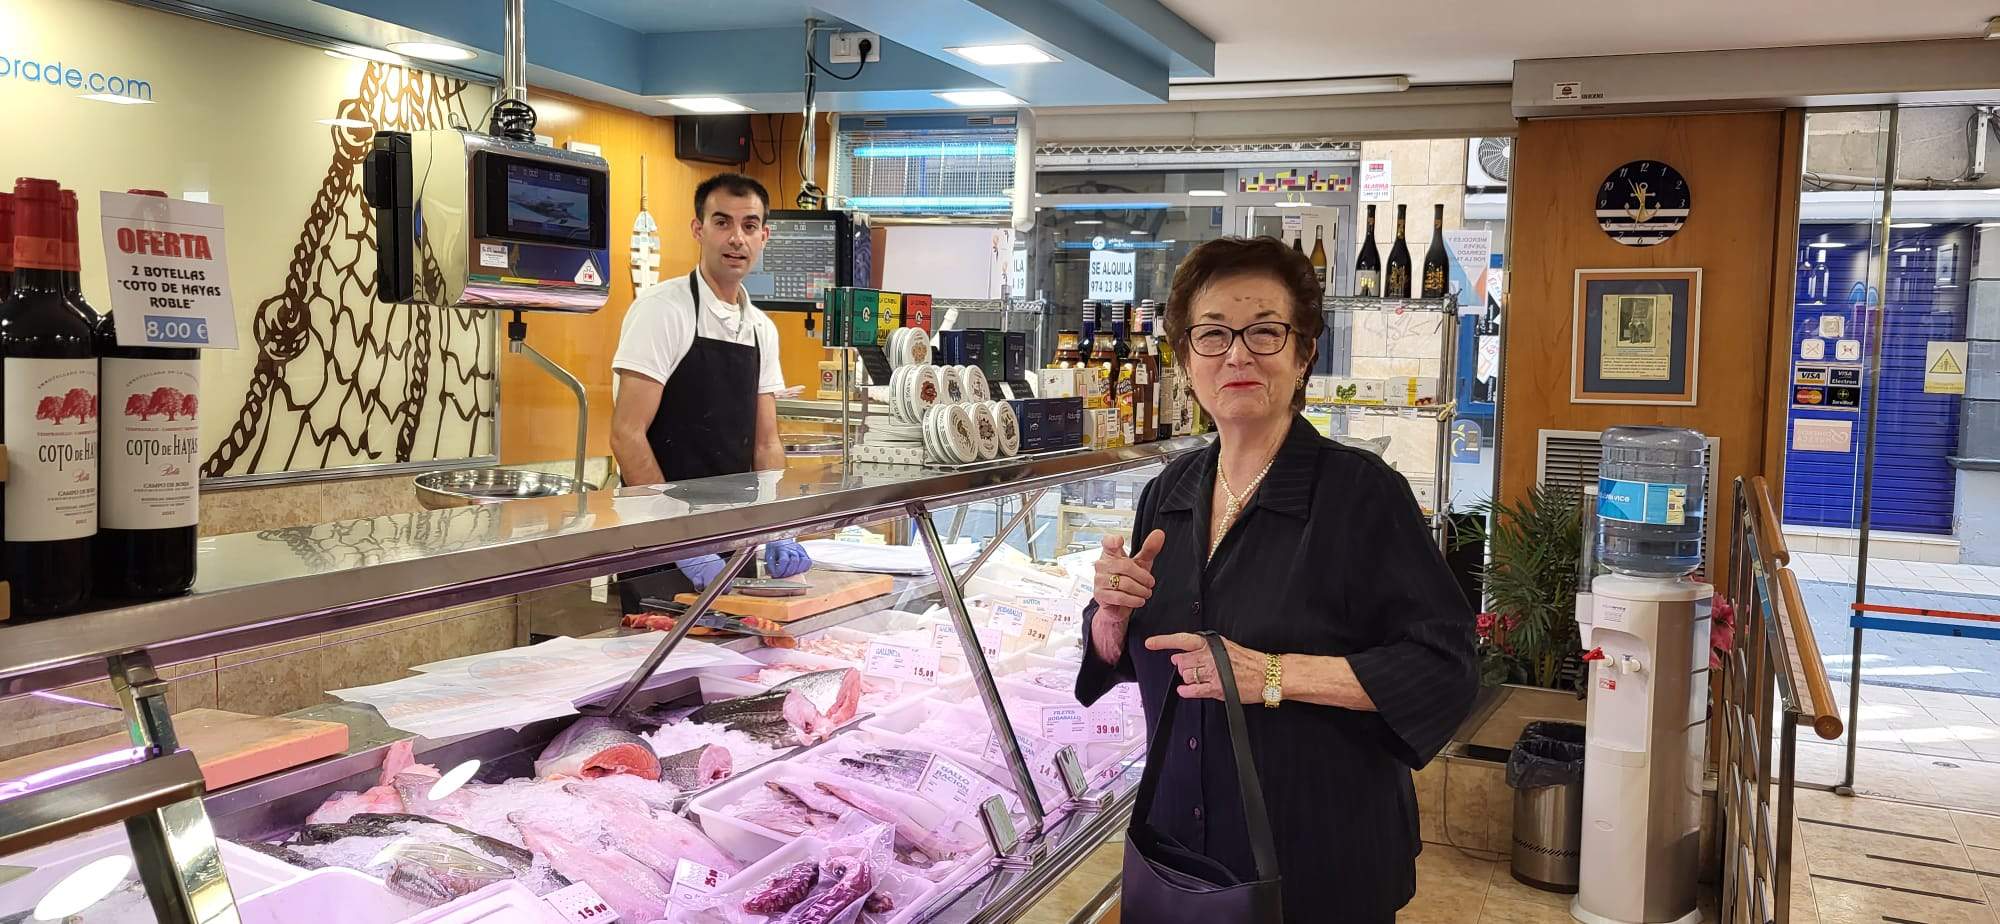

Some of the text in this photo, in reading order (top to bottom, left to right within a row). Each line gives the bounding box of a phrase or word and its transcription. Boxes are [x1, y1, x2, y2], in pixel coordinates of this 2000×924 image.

[1620, 168, 1628, 177] 11
[1640, 162, 1650, 173] 12
[1661, 167, 1667, 177] 1
[1604, 181, 1614, 191] 10
[1675, 180, 1683, 190] 2
[1600, 199, 1607, 208] 9
[1679, 198, 1686, 208] 3
[117, 227, 213, 260] OFERTA
[131, 265, 205, 281] 2 BOTELLAS
[1091, 262, 1133, 275] SE ALQUILA
[162, 282, 178, 293] DE
[182, 284, 221, 297] HAYAS
[1090, 281, 1103, 293] 974
[1105, 281, 1112, 293] 23
[1125, 281, 1133, 293] 19
[147, 320, 208, 340] 8,00 €
[126, 434, 198, 465] COTO DE HAYAS
[39, 443, 73, 472] COTO
[75, 449, 84, 461] DE
[941, 765, 970, 786] GALLO
